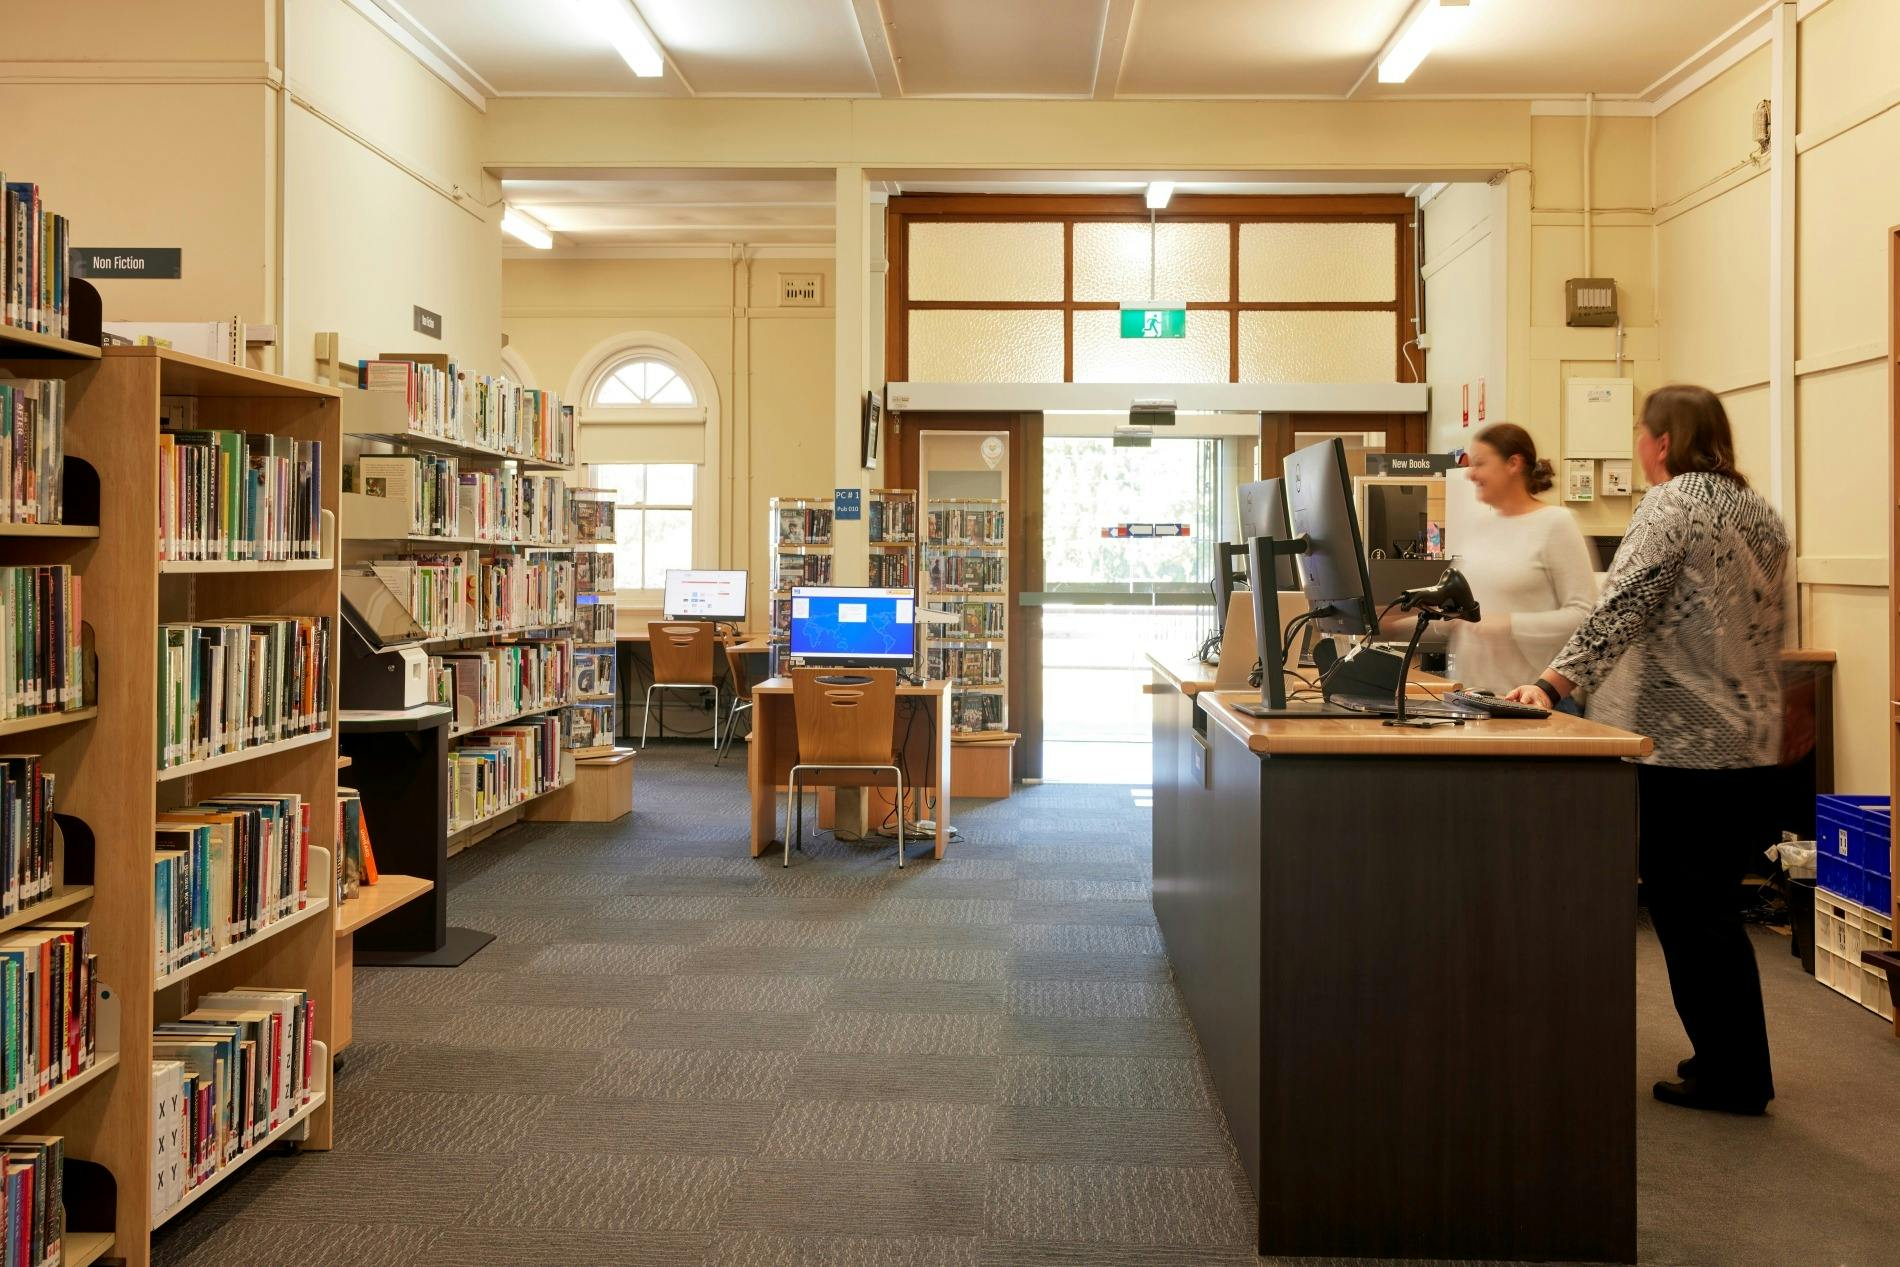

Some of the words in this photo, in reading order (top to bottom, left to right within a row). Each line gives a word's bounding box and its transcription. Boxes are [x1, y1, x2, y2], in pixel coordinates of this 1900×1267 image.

[93, 256, 112, 269] Non
[115, 255, 145, 269] Fiction
[16, 403, 24, 436] AFTER
[1392, 459, 1408, 469] New
[1410, 459, 1430, 469] Books
[836, 491, 847, 499] PC
[855, 491, 859, 499] 1
[158, 1100, 165, 1119] X
[171, 1094, 178, 1112] Y
[158, 1136, 165, 1155] X
[171, 1129, 178, 1147] Y
[157, 1171, 164, 1190] X
[171, 1163, 178, 1181] Y
